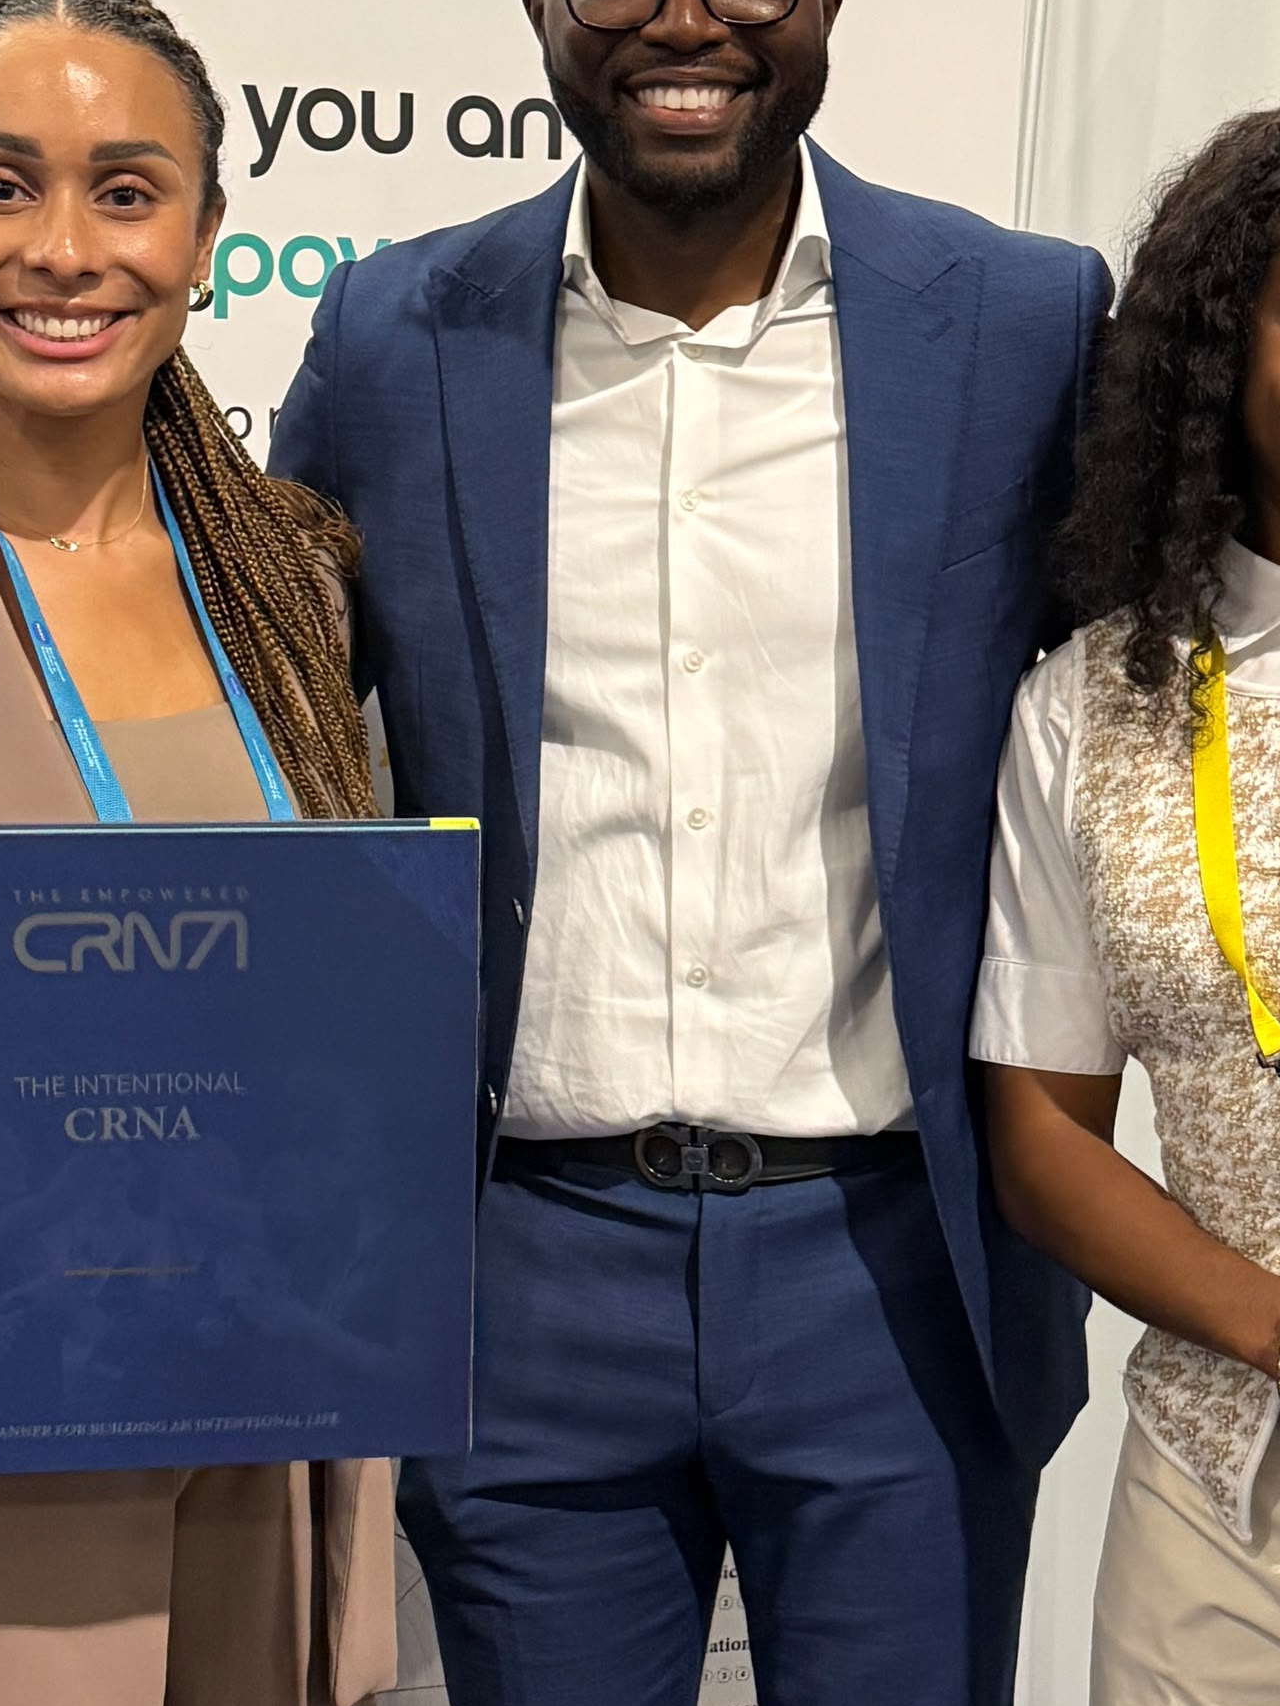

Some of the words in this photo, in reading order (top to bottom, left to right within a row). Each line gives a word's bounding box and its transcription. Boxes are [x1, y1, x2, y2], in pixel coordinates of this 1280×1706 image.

[241, 84, 415, 178] you
[13, 887, 62, 904] THE
[80, 886, 249, 902] EMPOWERED
[13, 1075, 65, 1099] THE
[73, 1071, 248, 1097] INTENTIONAL
[63, 1105, 201, 1142] CRNA
